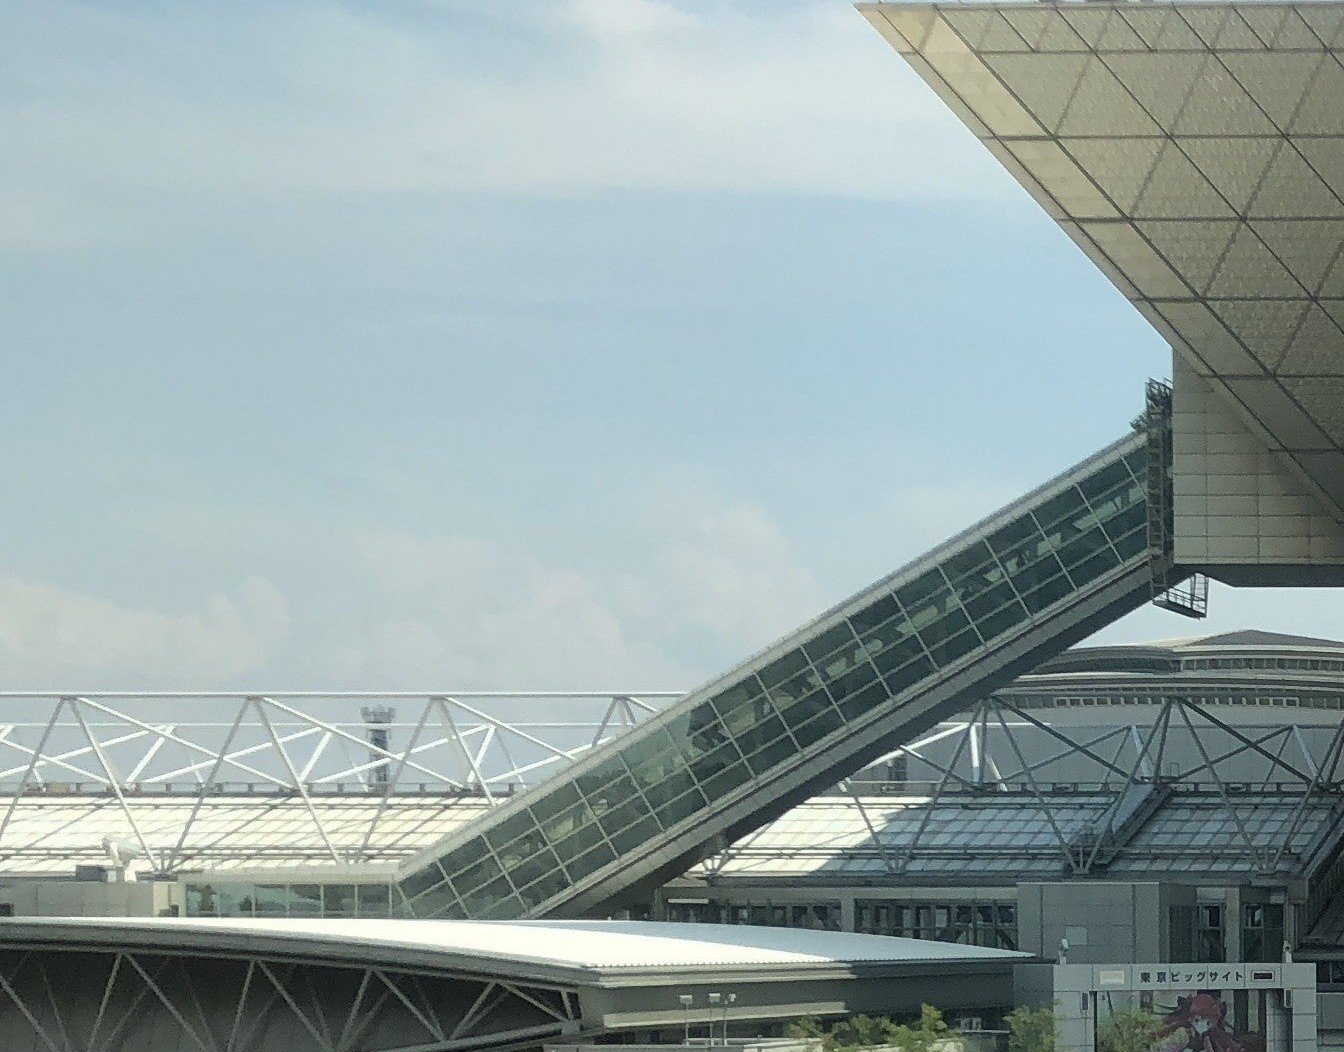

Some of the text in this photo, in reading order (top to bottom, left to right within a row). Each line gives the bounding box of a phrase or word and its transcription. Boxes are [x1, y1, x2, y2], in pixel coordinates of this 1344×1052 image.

[1140, 971, 1243, 983] 東京ビッグサイト
